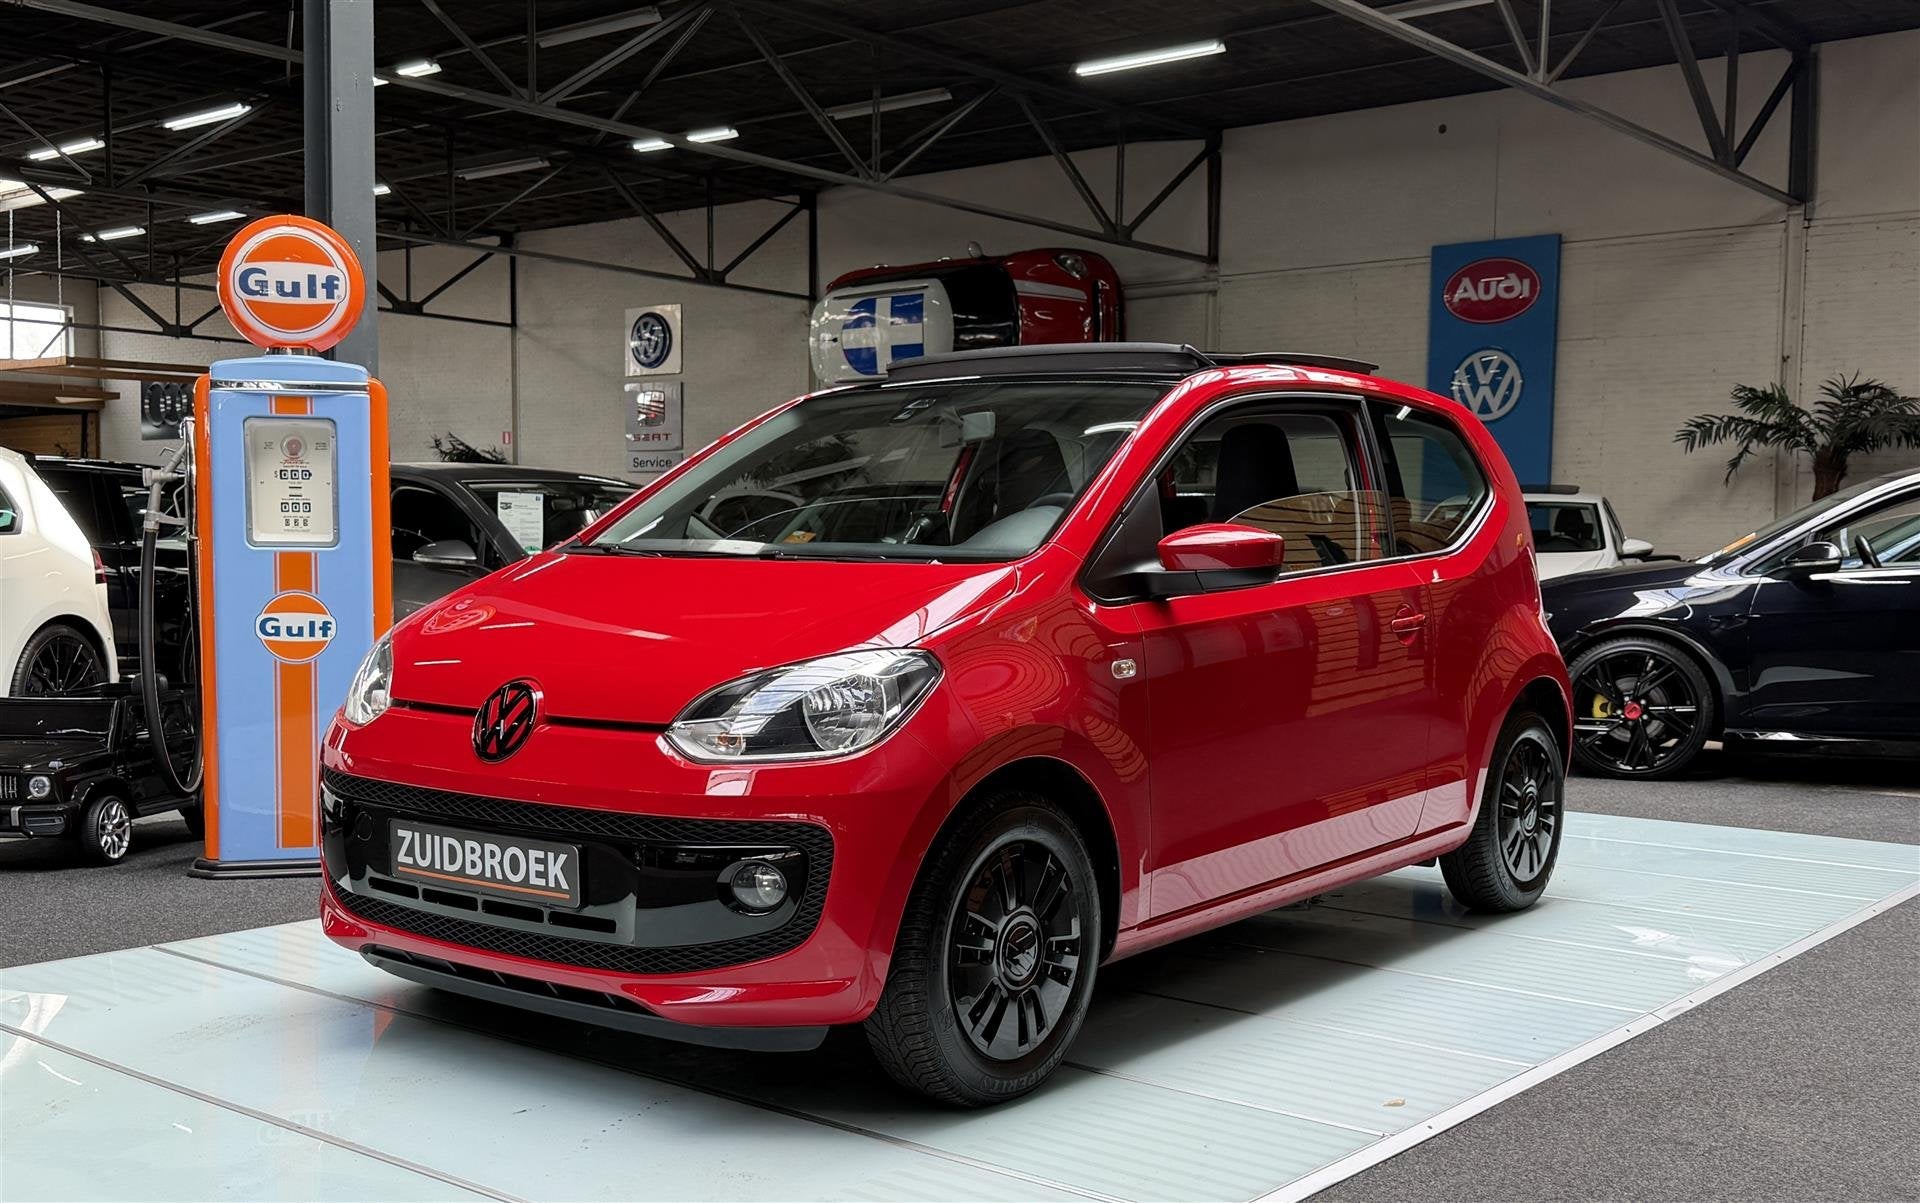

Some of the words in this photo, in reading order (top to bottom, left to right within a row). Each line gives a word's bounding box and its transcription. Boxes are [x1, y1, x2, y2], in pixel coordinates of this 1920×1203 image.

[238, 267, 340, 300] Gulf
[1453, 273, 1530, 303] Audi
[1453, 350, 1522, 421] VW
[633, 432, 672, 442] SEAT
[633, 457, 672, 468] Service
[259, 617, 333, 637] Gulf
[397, 829, 570, 890] ZUIDBROEK
